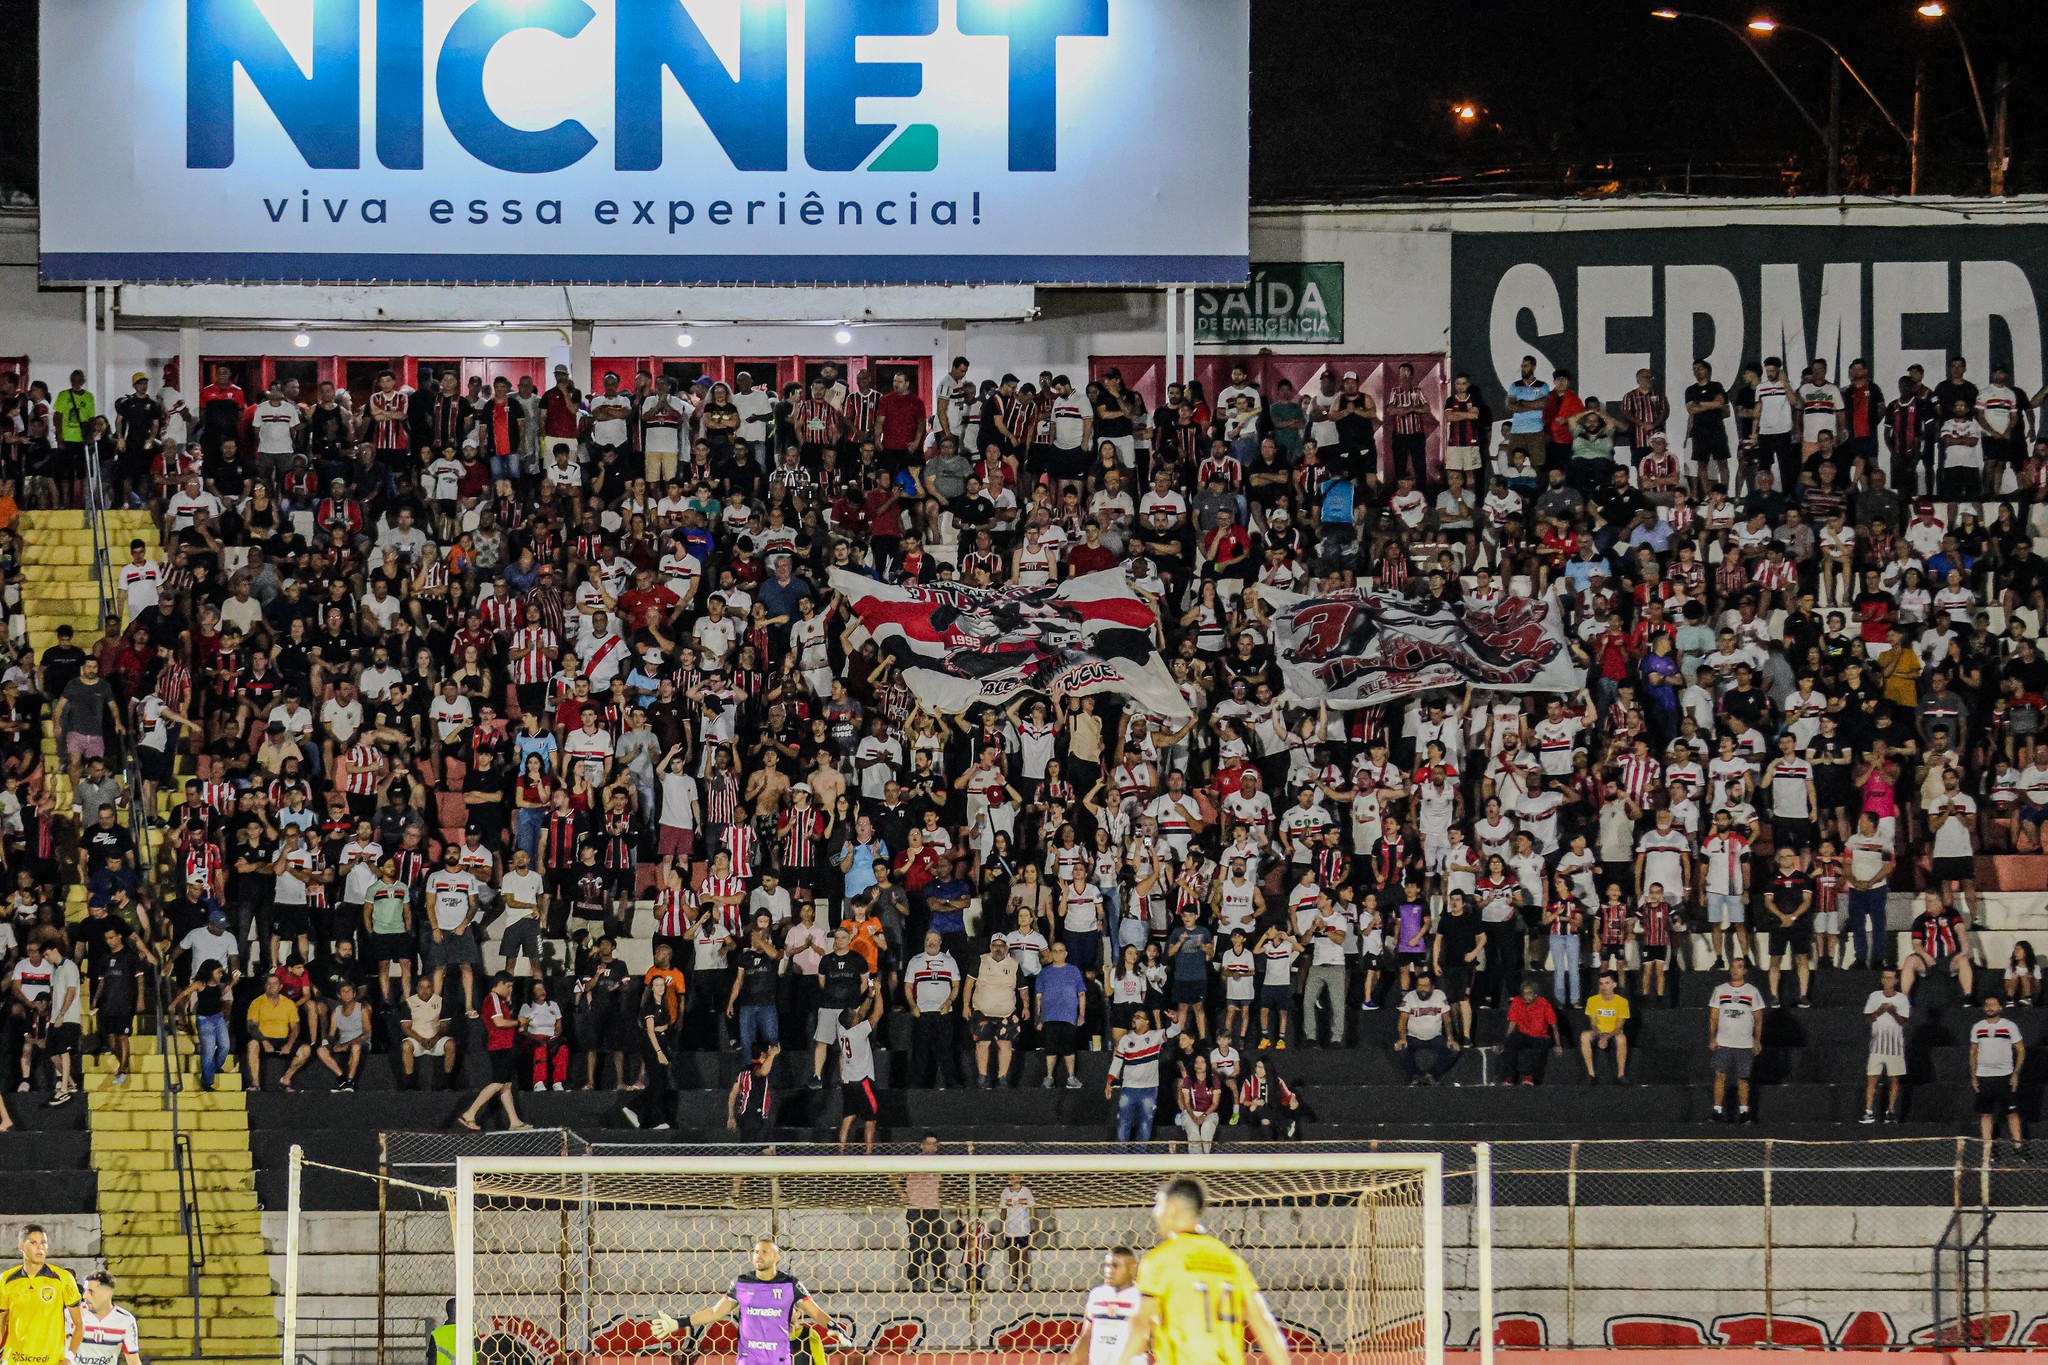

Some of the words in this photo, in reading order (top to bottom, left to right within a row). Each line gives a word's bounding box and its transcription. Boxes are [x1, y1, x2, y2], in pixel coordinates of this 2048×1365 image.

[186, 0, 1109, 173] NICNET
[263, 189, 387, 223] viva
[429, 199, 563, 225] essa
[594, 191, 981, 234] experiência!
[1198, 271, 1328, 315] SAÍDA
[1198, 317, 1218, 331] DE
[1222, 316, 1330, 333] EMERGÊNCIA
[951, 634, 981, 646] 1992
[1193, 1281, 1237, 1335] 14
[20, 1353, 51, 1363] Sicredi
[748, 1340, 778, 1351] NICNET
